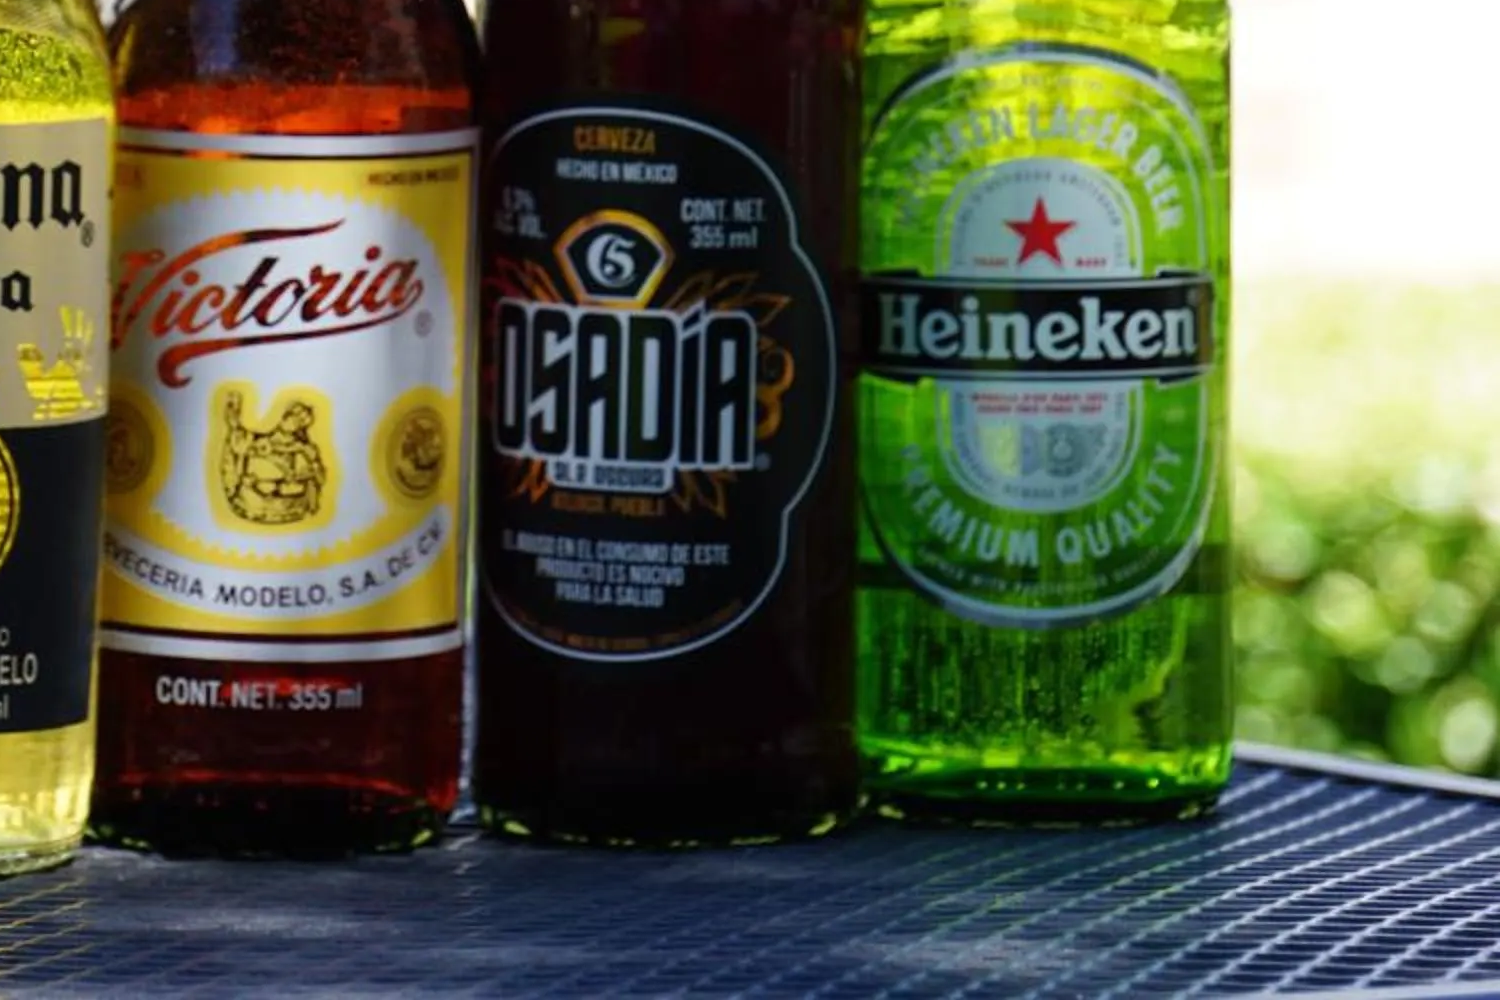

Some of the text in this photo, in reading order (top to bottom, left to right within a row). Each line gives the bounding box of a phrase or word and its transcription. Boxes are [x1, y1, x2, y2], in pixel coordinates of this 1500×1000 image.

[573, 125, 656, 154] CERVEZA
[600, 161, 620, 182] EN
[689, 226, 759, 249] 355 ml
[111, 218, 424, 389] Victoria
[878, 294, 1198, 362] Heineken
[1056, 442, 1182, 564] QUALITY
[386, 547, 414, 579] DE
[670, 543, 691, 564] DE
[693, 543, 730, 565] ESTE
[607, 563, 626, 582] ES
[593, 584, 612, 604] LA
[615, 586, 665, 608] SALUD
[156, 675, 362, 710] CONT. NET. 355 ml
